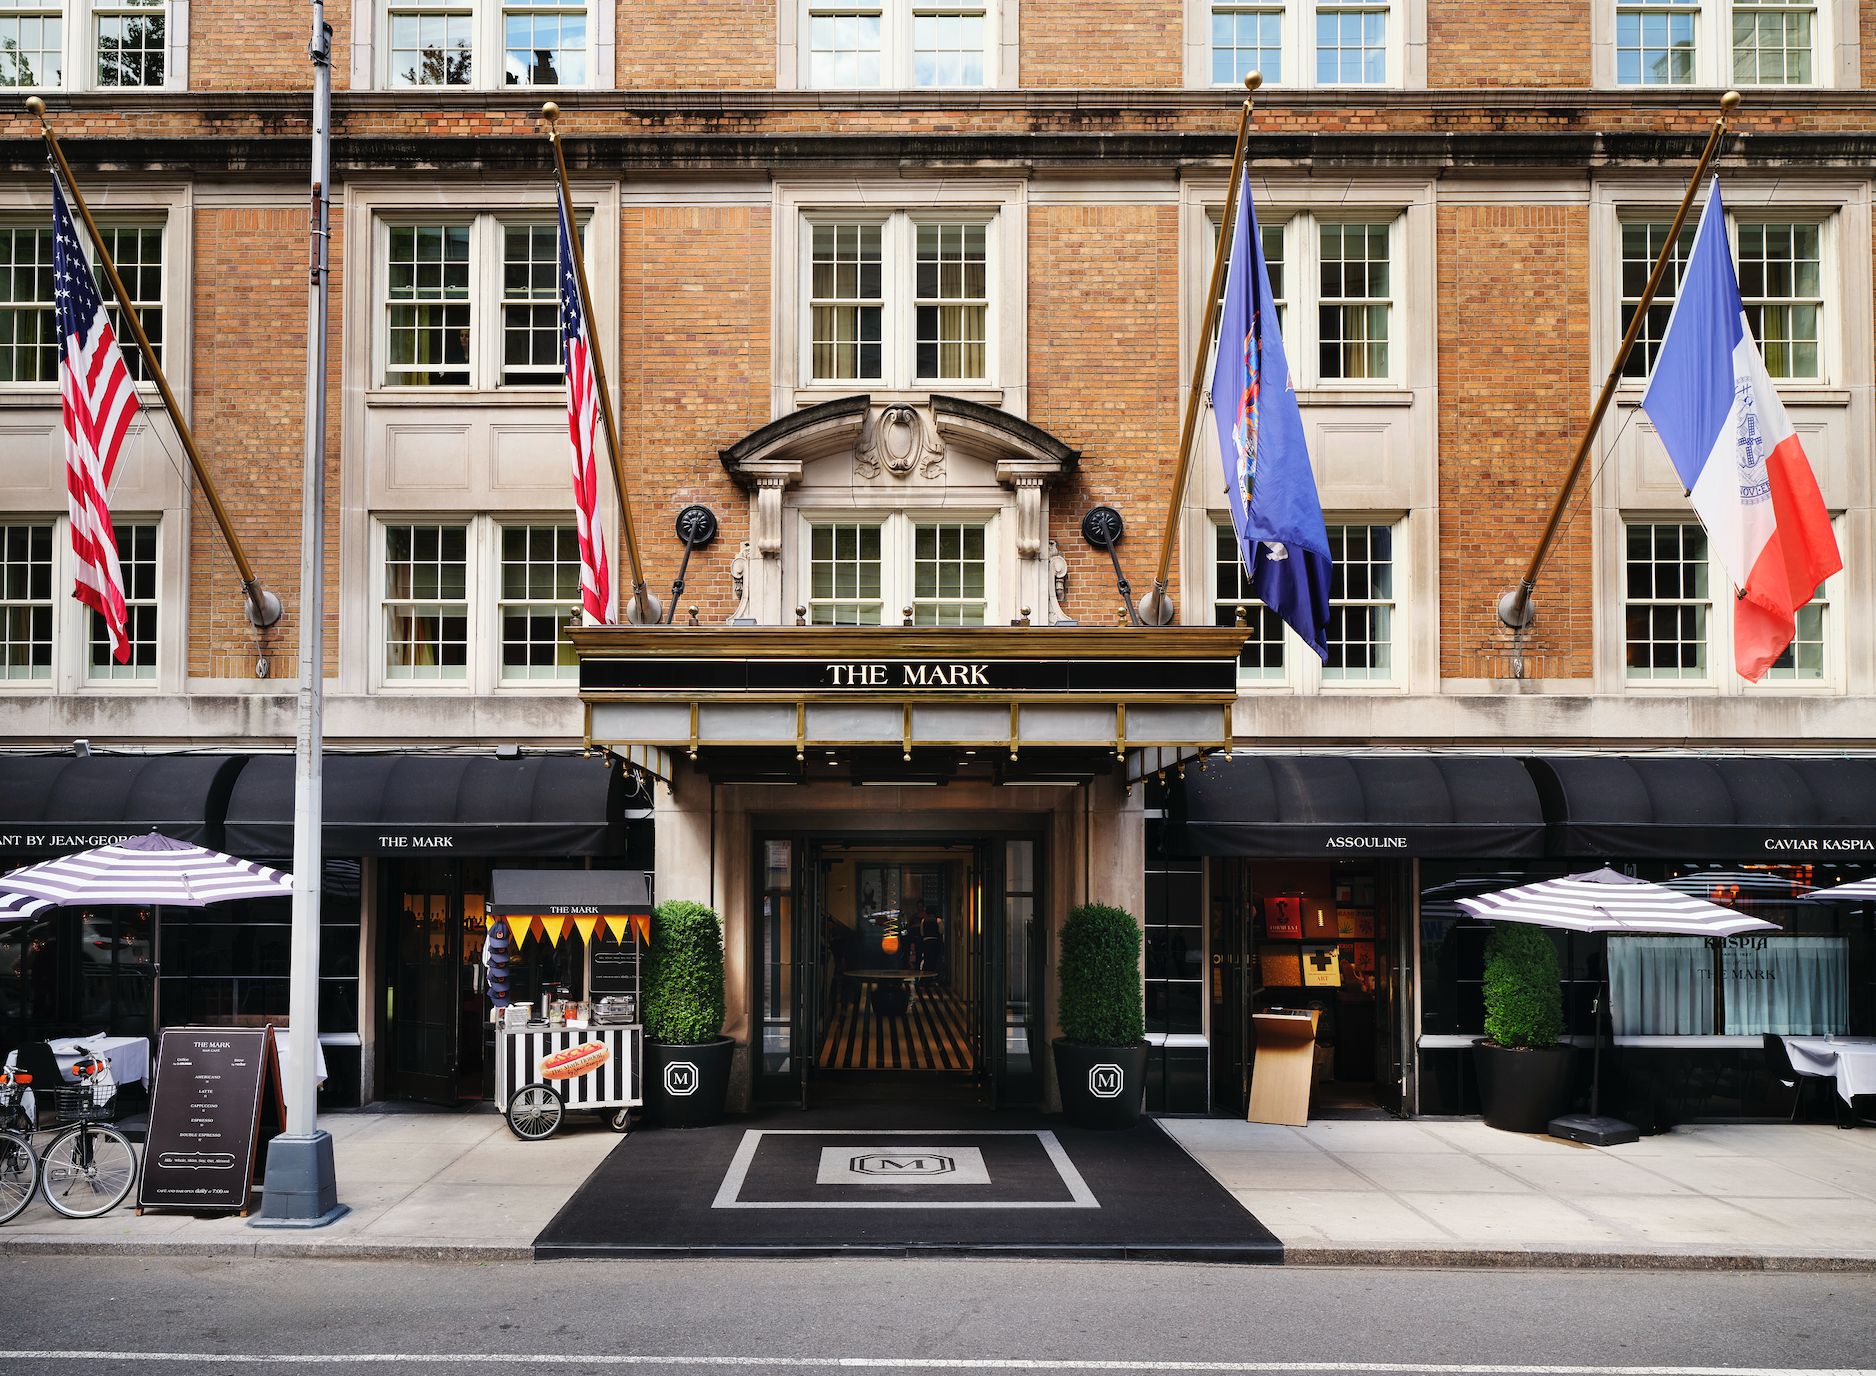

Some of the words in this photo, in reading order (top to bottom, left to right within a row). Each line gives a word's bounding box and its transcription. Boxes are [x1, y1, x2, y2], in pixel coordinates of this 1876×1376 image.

[826, 664, 888, 685] THE
[903, 664, 989, 685] MARK
[26, 835, 45, 846] BY
[378, 836, 408, 847] THE
[411, 836, 453, 847] MARK
[1325, 836, 1408, 848] ASSOULINE
[1764, 838, 1818, 850] CAVIAR
[1822, 839, 1875, 850] KASPIA
[549, 906, 569, 914] THE
[570, 906, 599, 914] MARK
[1732, 969, 1776, 980] MARK
[673, 1072, 688, 1085] M
[1098, 1073, 1115, 1087] M
[878, 1159, 928, 1170] M
